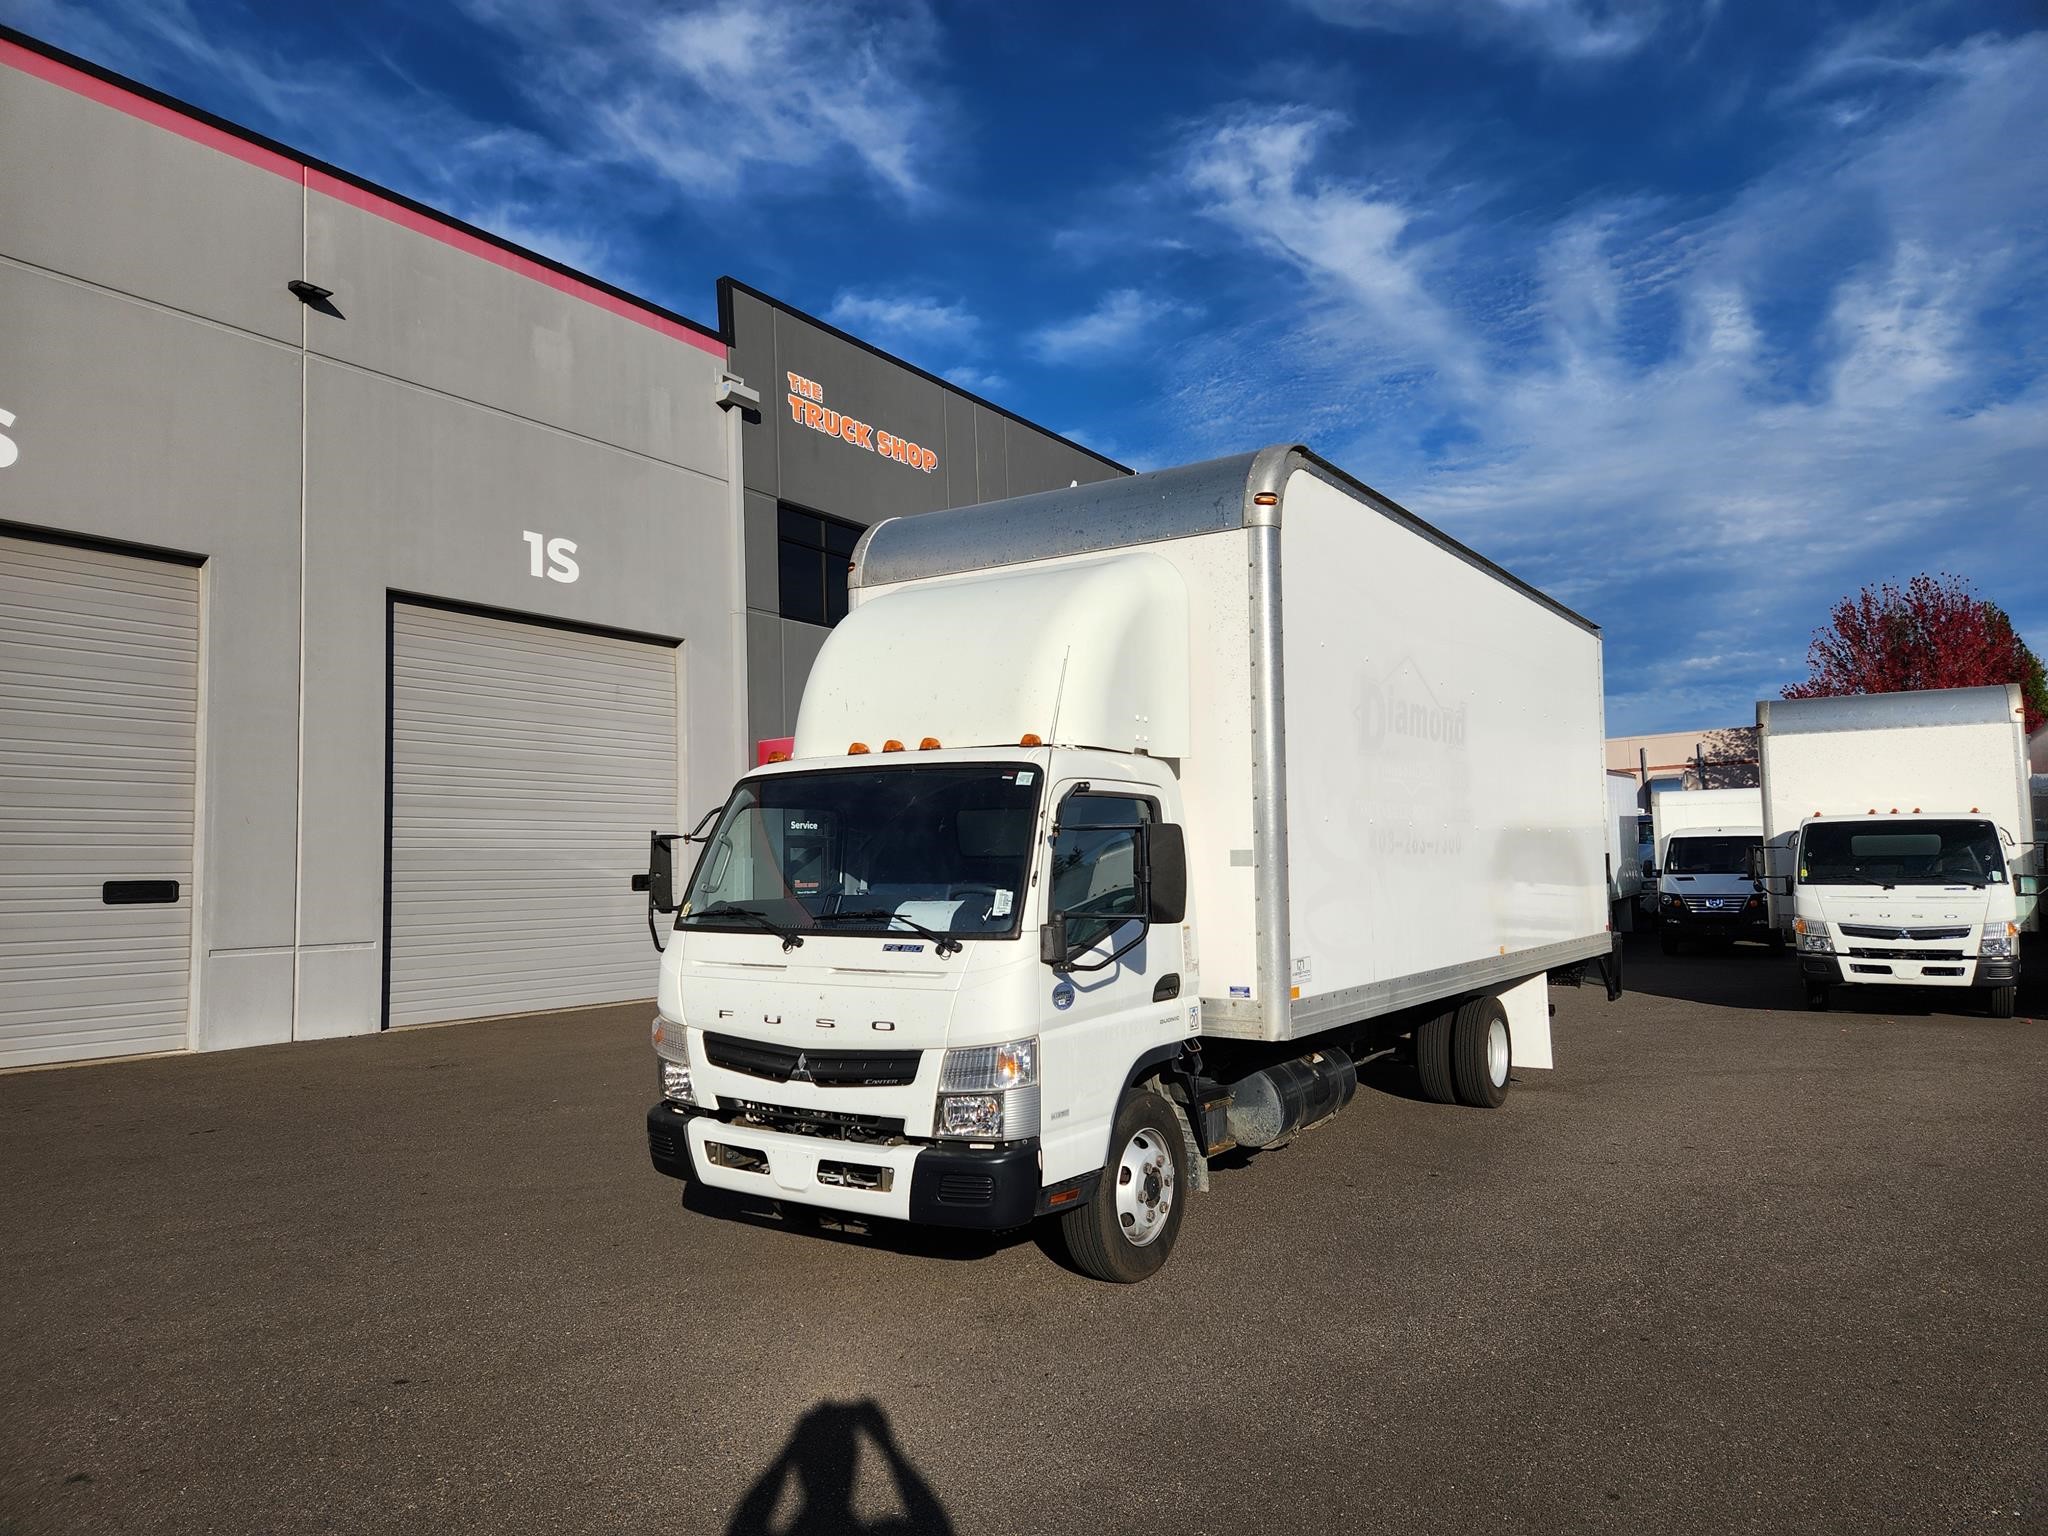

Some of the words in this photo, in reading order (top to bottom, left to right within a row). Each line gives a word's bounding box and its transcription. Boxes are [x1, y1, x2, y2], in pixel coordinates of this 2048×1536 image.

[787, 371, 823, 403] THE
[788, 393, 874, 451] TRUCK
[877, 430, 938, 473] SHOP
[523, 530, 580, 583] 1S
[1359, 678, 1466, 752] Diamond
[790, 820, 818, 830] Service
[719, 1009, 896, 1032] FUSO
